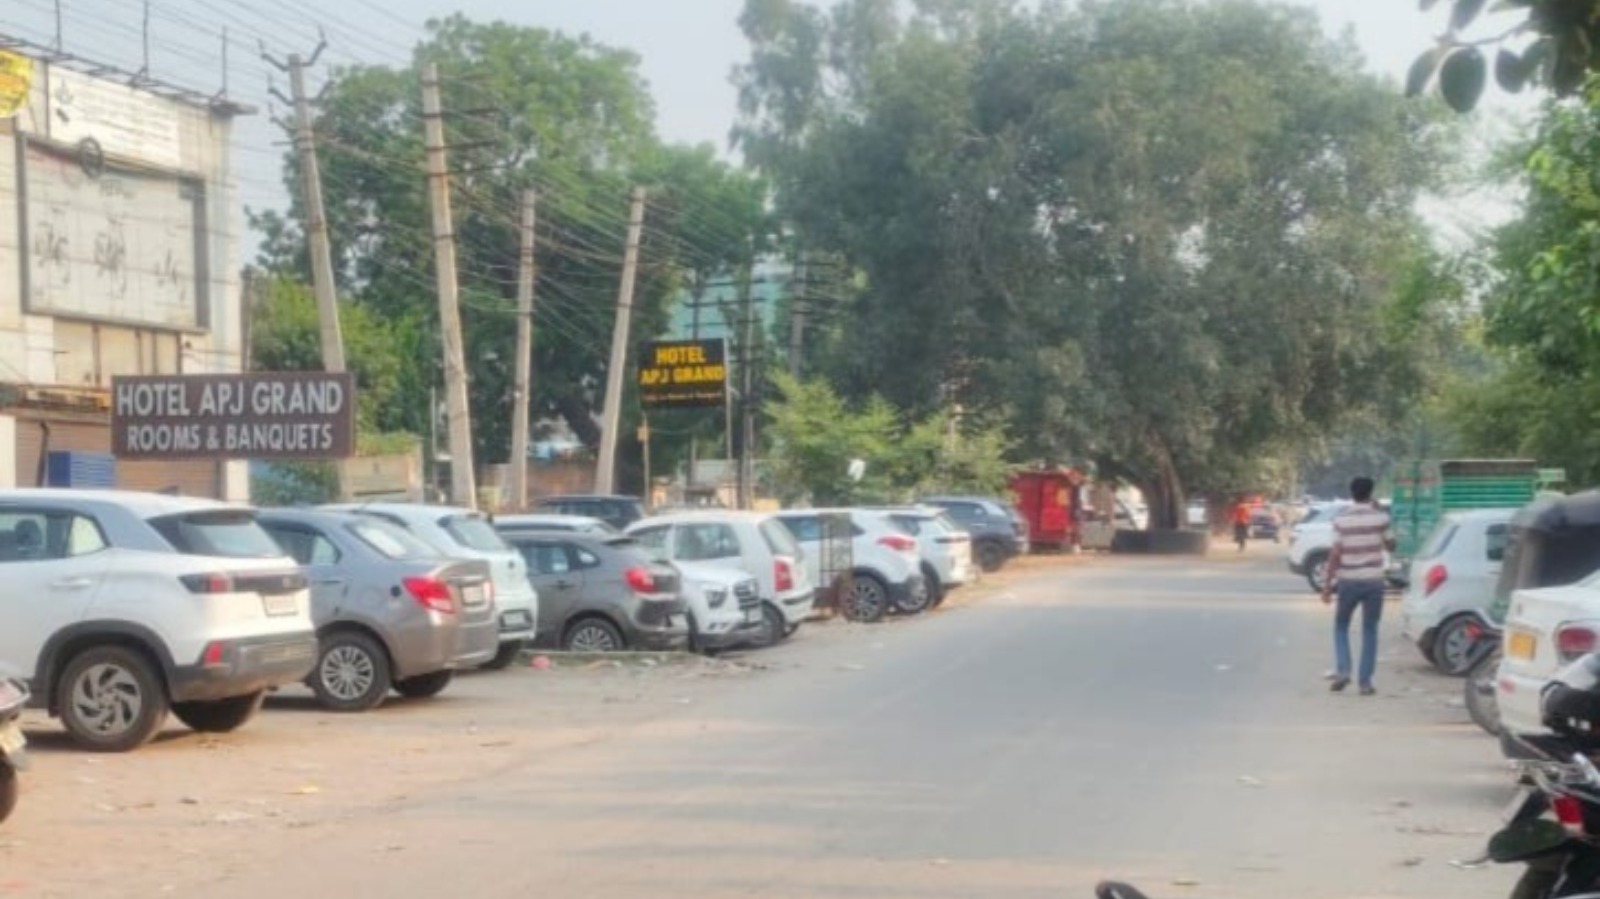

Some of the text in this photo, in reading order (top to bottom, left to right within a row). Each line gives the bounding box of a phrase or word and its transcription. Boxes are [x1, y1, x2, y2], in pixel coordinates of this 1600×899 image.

[656, 346, 706, 364] HOTEL
[641, 366, 724, 385] APJ GRAND
[117, 381, 343, 416] HOTEL APJ GRAND
[127, 423, 333, 451] ROOMS & BANQUETS
